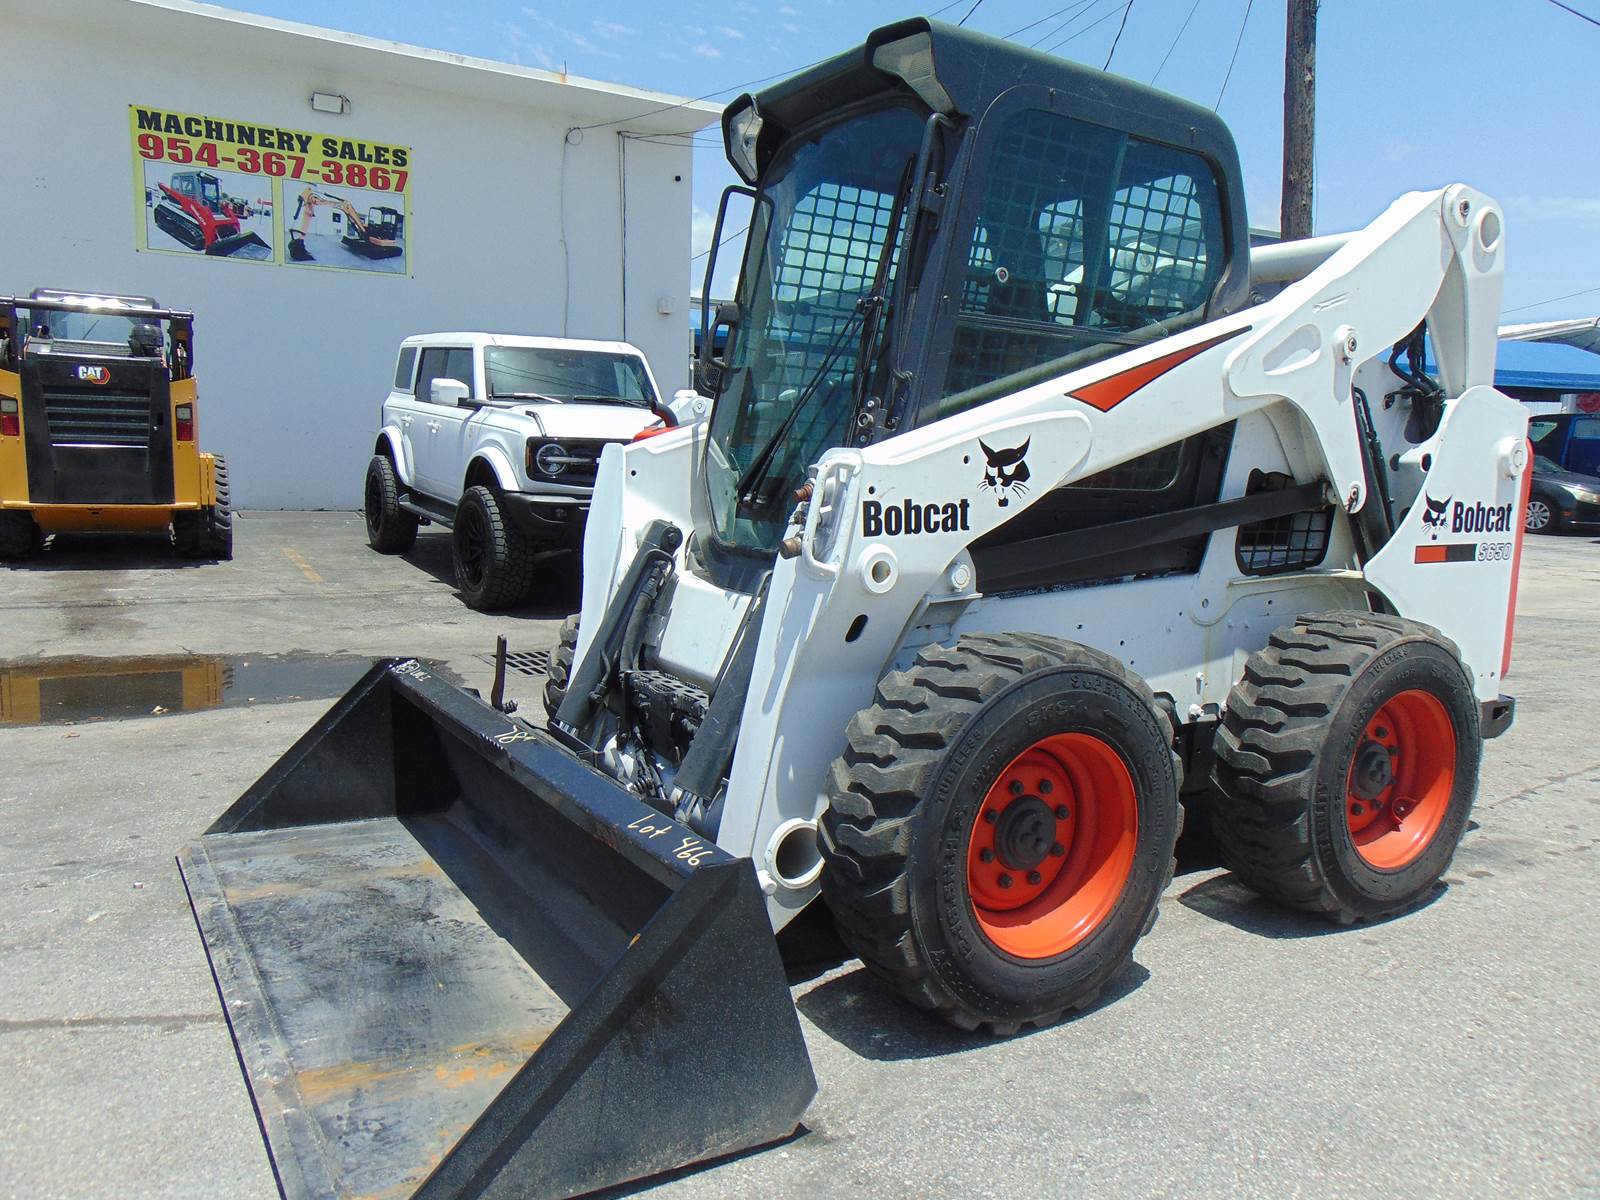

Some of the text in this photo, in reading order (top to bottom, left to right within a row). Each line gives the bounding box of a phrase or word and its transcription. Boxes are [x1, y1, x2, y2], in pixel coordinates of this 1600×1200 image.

[136, 109, 408, 167] MACHINERY SALES
[137, 133, 409, 193] 954-367-3867
[79, 366, 103, 380] CAT
[862, 498, 970, 537] Bobcat
[1451, 501, 1513, 533] Bobcat
[1478, 543, 1512, 561] S650
[672, 837, 713, 866] 466
